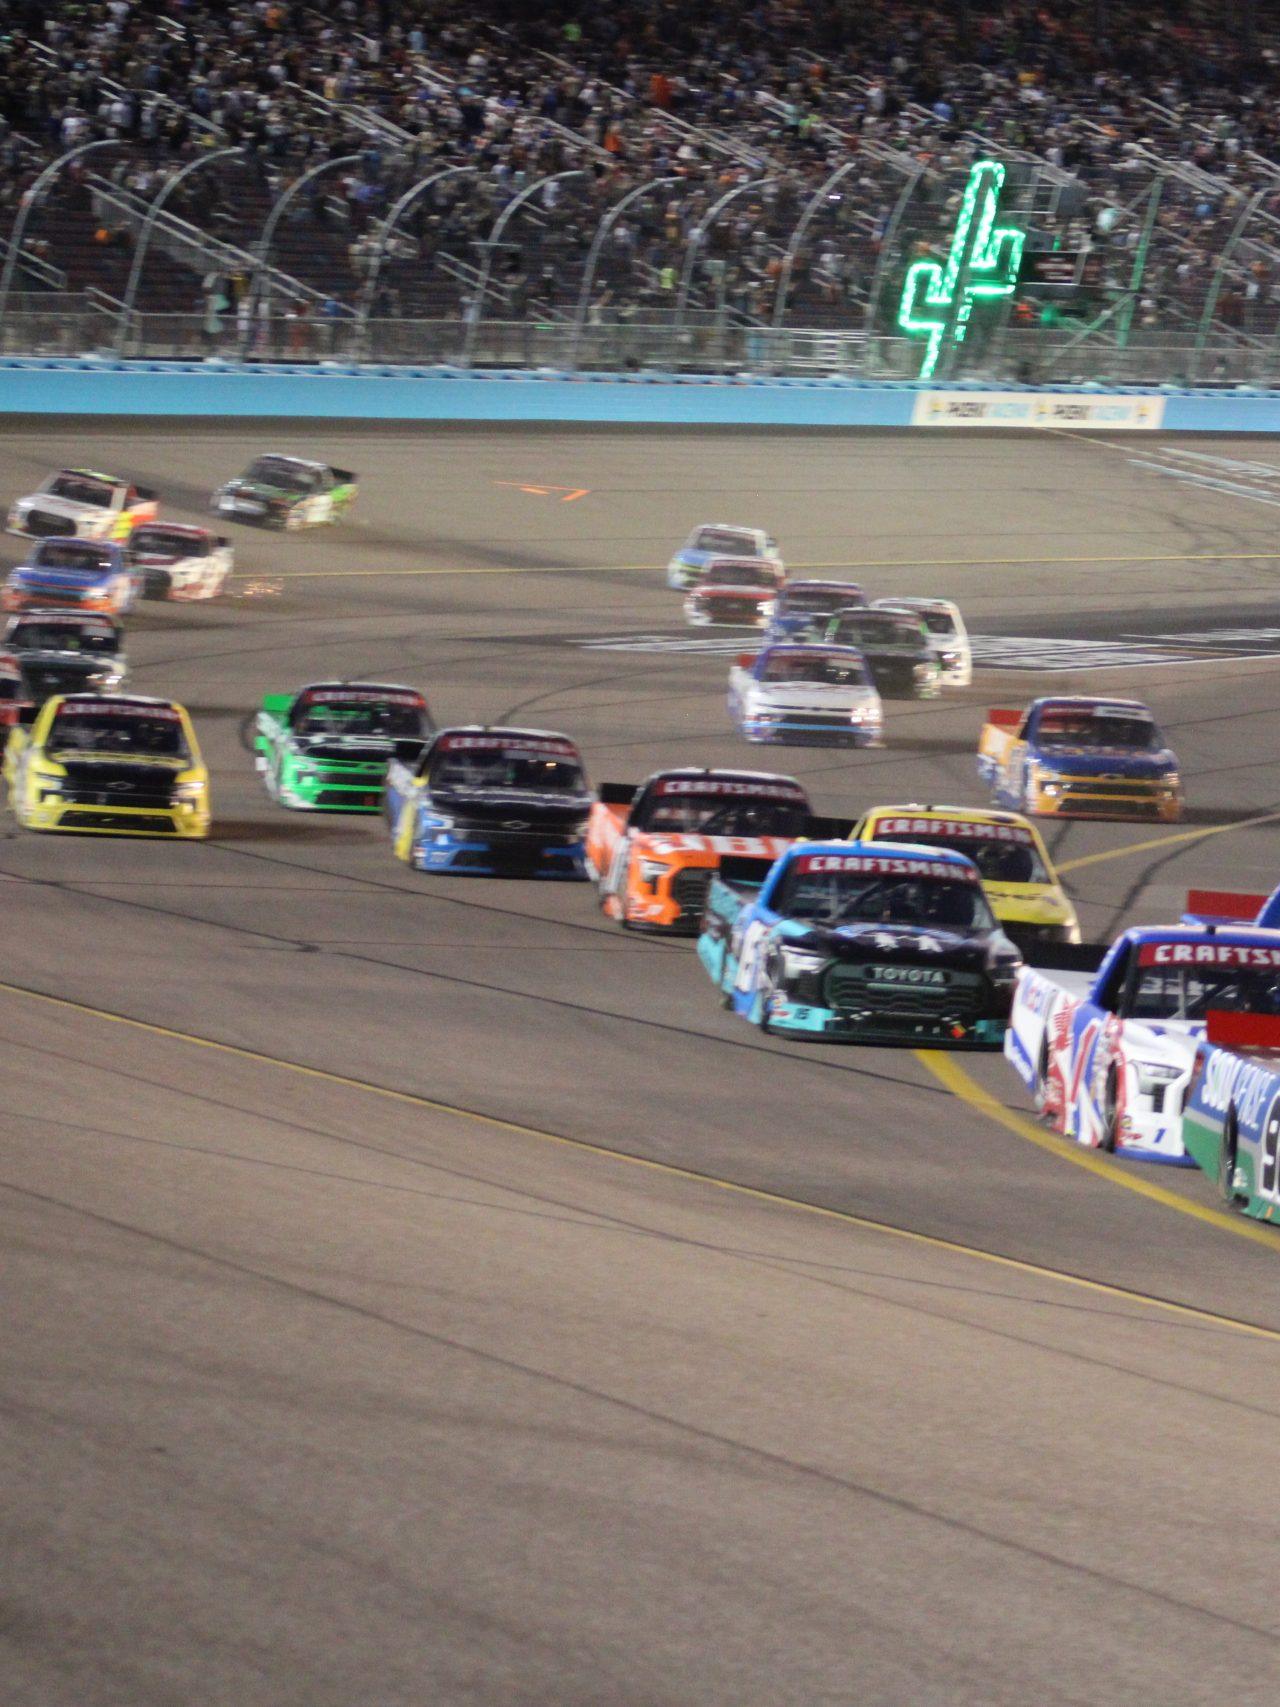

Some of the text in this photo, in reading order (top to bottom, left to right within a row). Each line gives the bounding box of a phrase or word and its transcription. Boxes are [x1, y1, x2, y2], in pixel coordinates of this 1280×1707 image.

[878, 818, 1033, 844] CRAFTSMAN
[808, 856, 967, 879] CRAFTSMAN
[873, 966, 946, 985] TOYOTA
